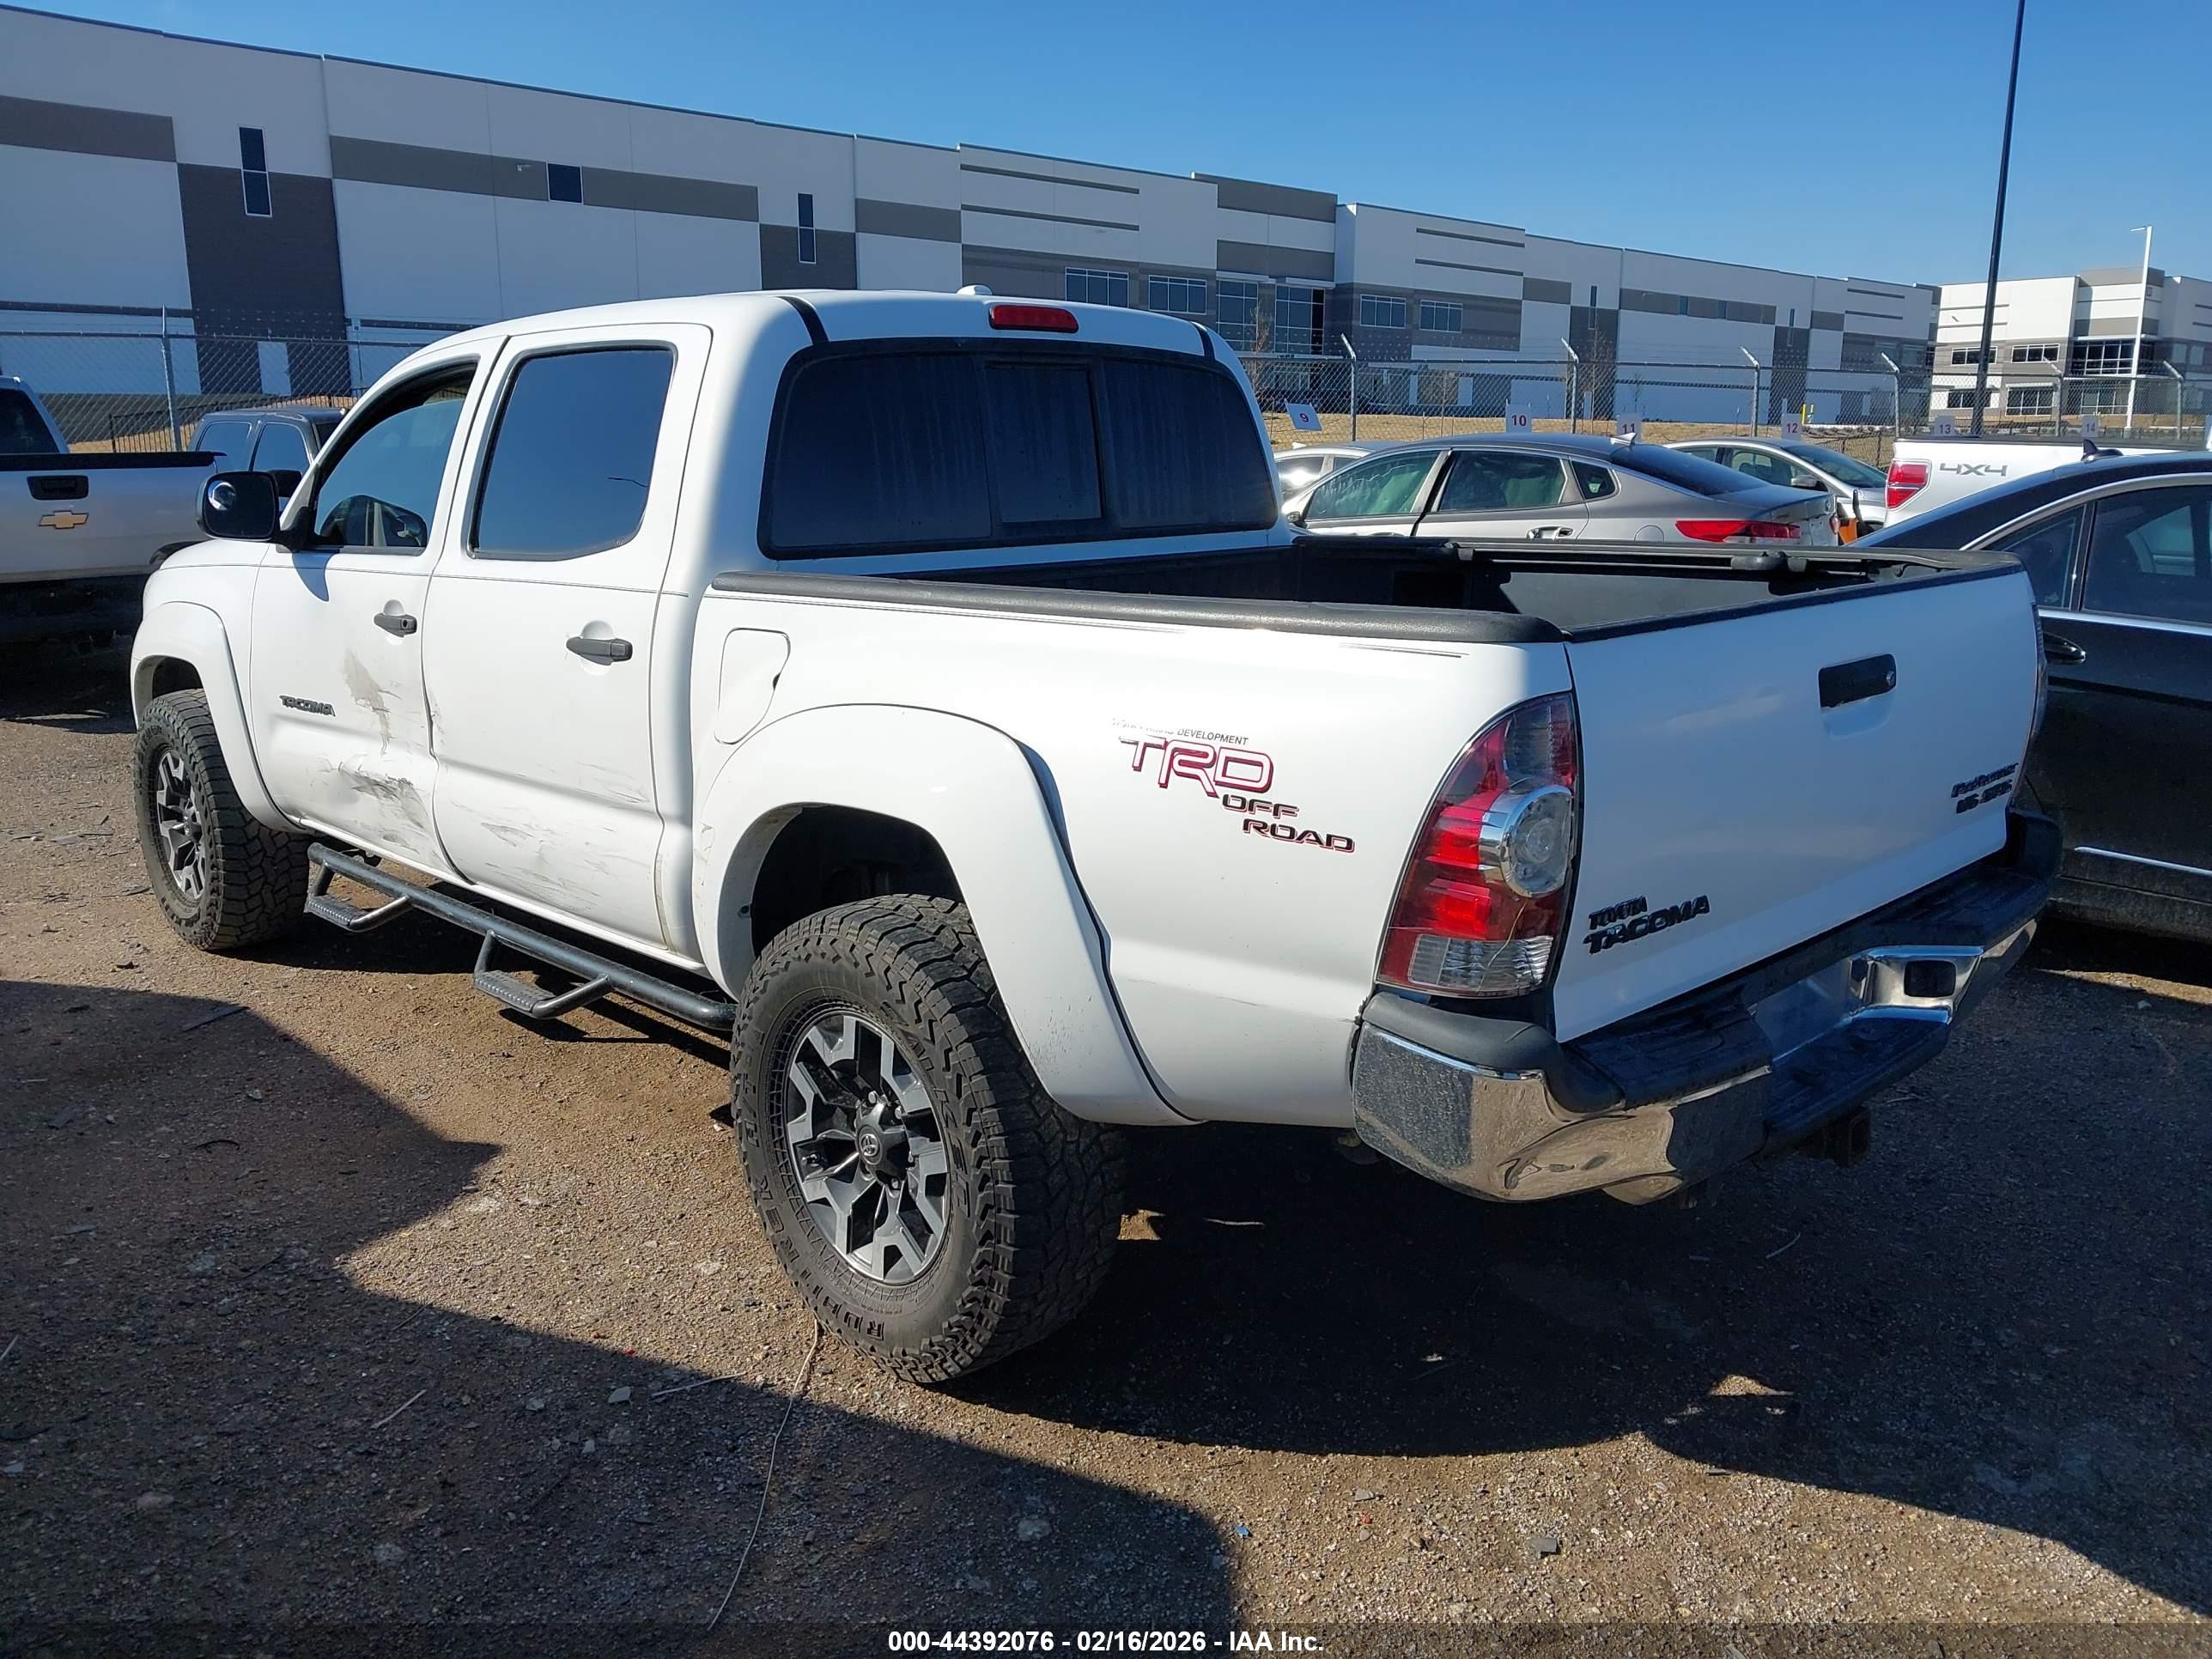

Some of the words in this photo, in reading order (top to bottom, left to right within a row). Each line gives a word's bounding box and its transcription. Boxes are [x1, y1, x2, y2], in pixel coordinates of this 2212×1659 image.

[1299, 412, 1310, 423] 9
[1511, 414, 1527, 427] 10
[1622, 422, 1635, 434] 11
[1786, 422, 1799, 434] 12
[1939, 423, 1952, 434] 13
[278, 695, 337, 718] TACOMA
[1177, 728, 1249, 746] DEVELOPMENT
[1118, 734, 1274, 799] TRD
[1222, 793, 1300, 819] OFF
[1243, 818, 1356, 854] ROAD
[1583, 895, 1711, 955] TACOMA
